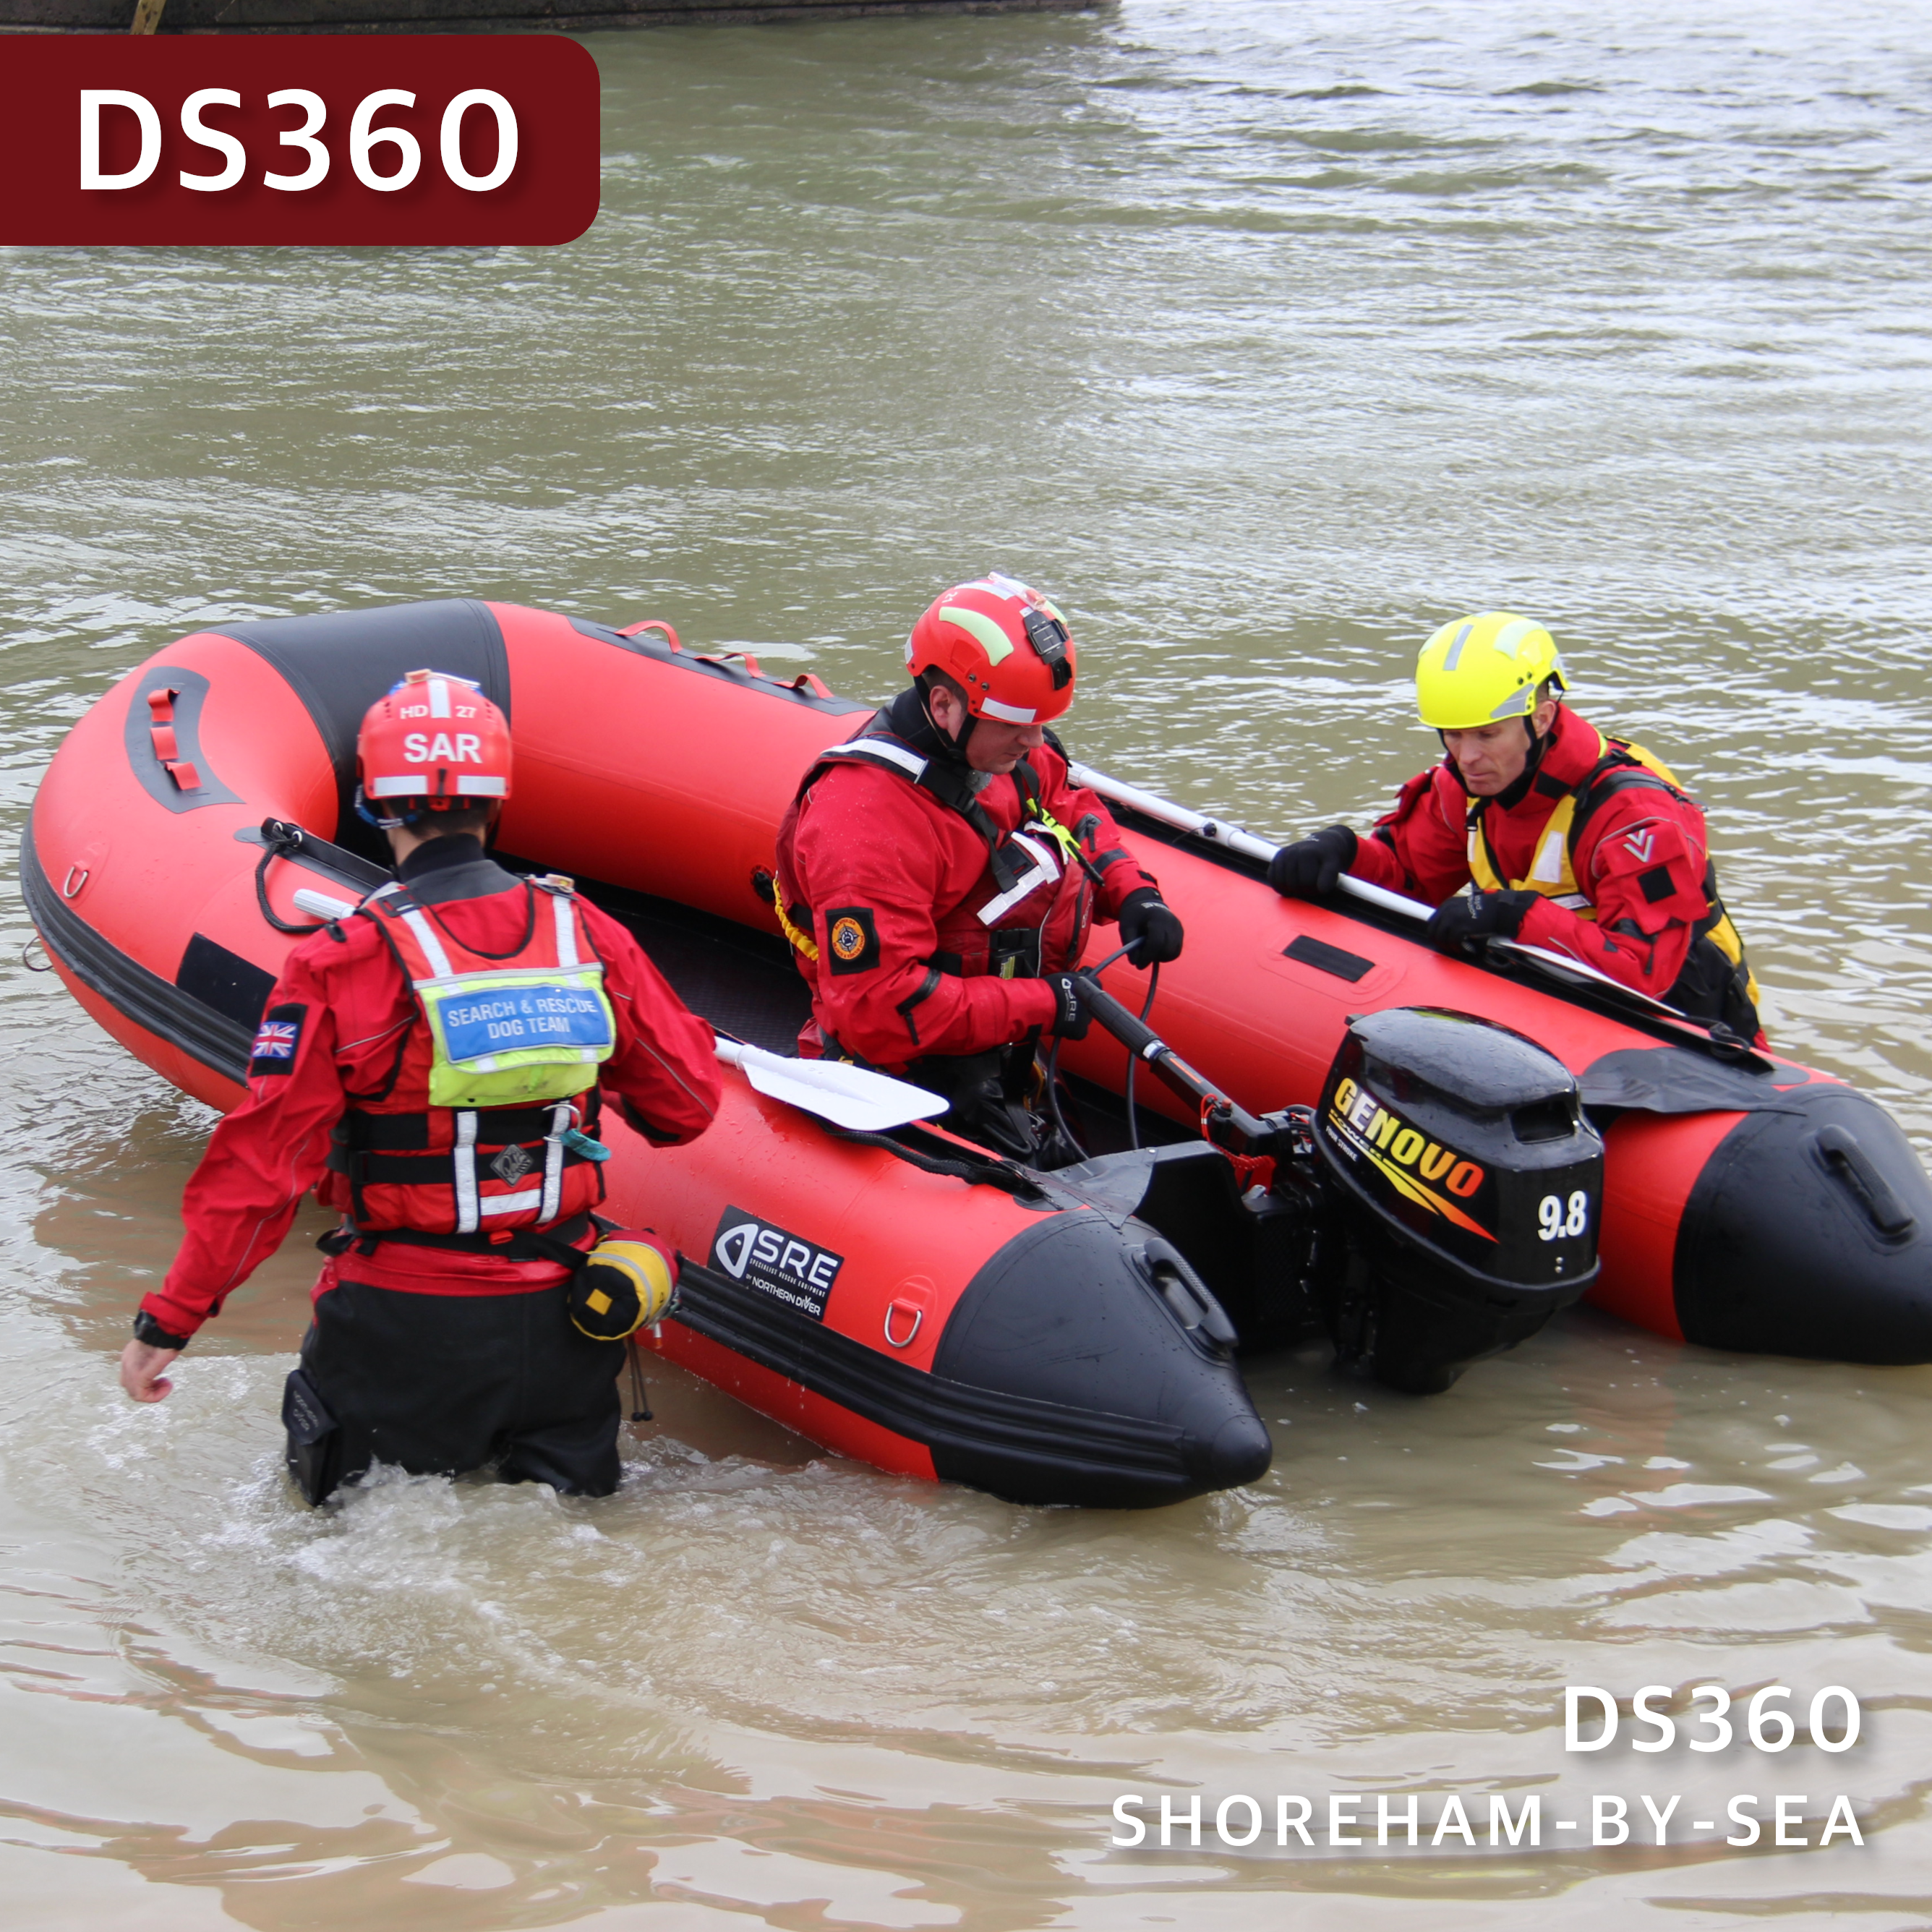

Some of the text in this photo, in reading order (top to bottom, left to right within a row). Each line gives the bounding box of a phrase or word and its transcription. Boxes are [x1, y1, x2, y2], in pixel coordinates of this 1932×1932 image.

[400, 705, 477, 719] HD 27
[403, 732, 483, 764] SAR
[448, 997, 599, 1027] SEARCH & RESCUE
[487, 1017, 571, 1040] DOG TEAM
[1325, 1125, 1358, 1162] FOUR STROKE
[1334, 1077, 1485, 1198] GENOVO
[1537, 1190, 1587, 1241] 9.8
[749, 1257, 826, 1298] SPECIALIST RESCUE EQUIPMENT
[752, 1229, 839, 1289] SRE
[752, 1276, 796, 1304] NORTHERN
[795, 1295, 821, 1316] DIVER
